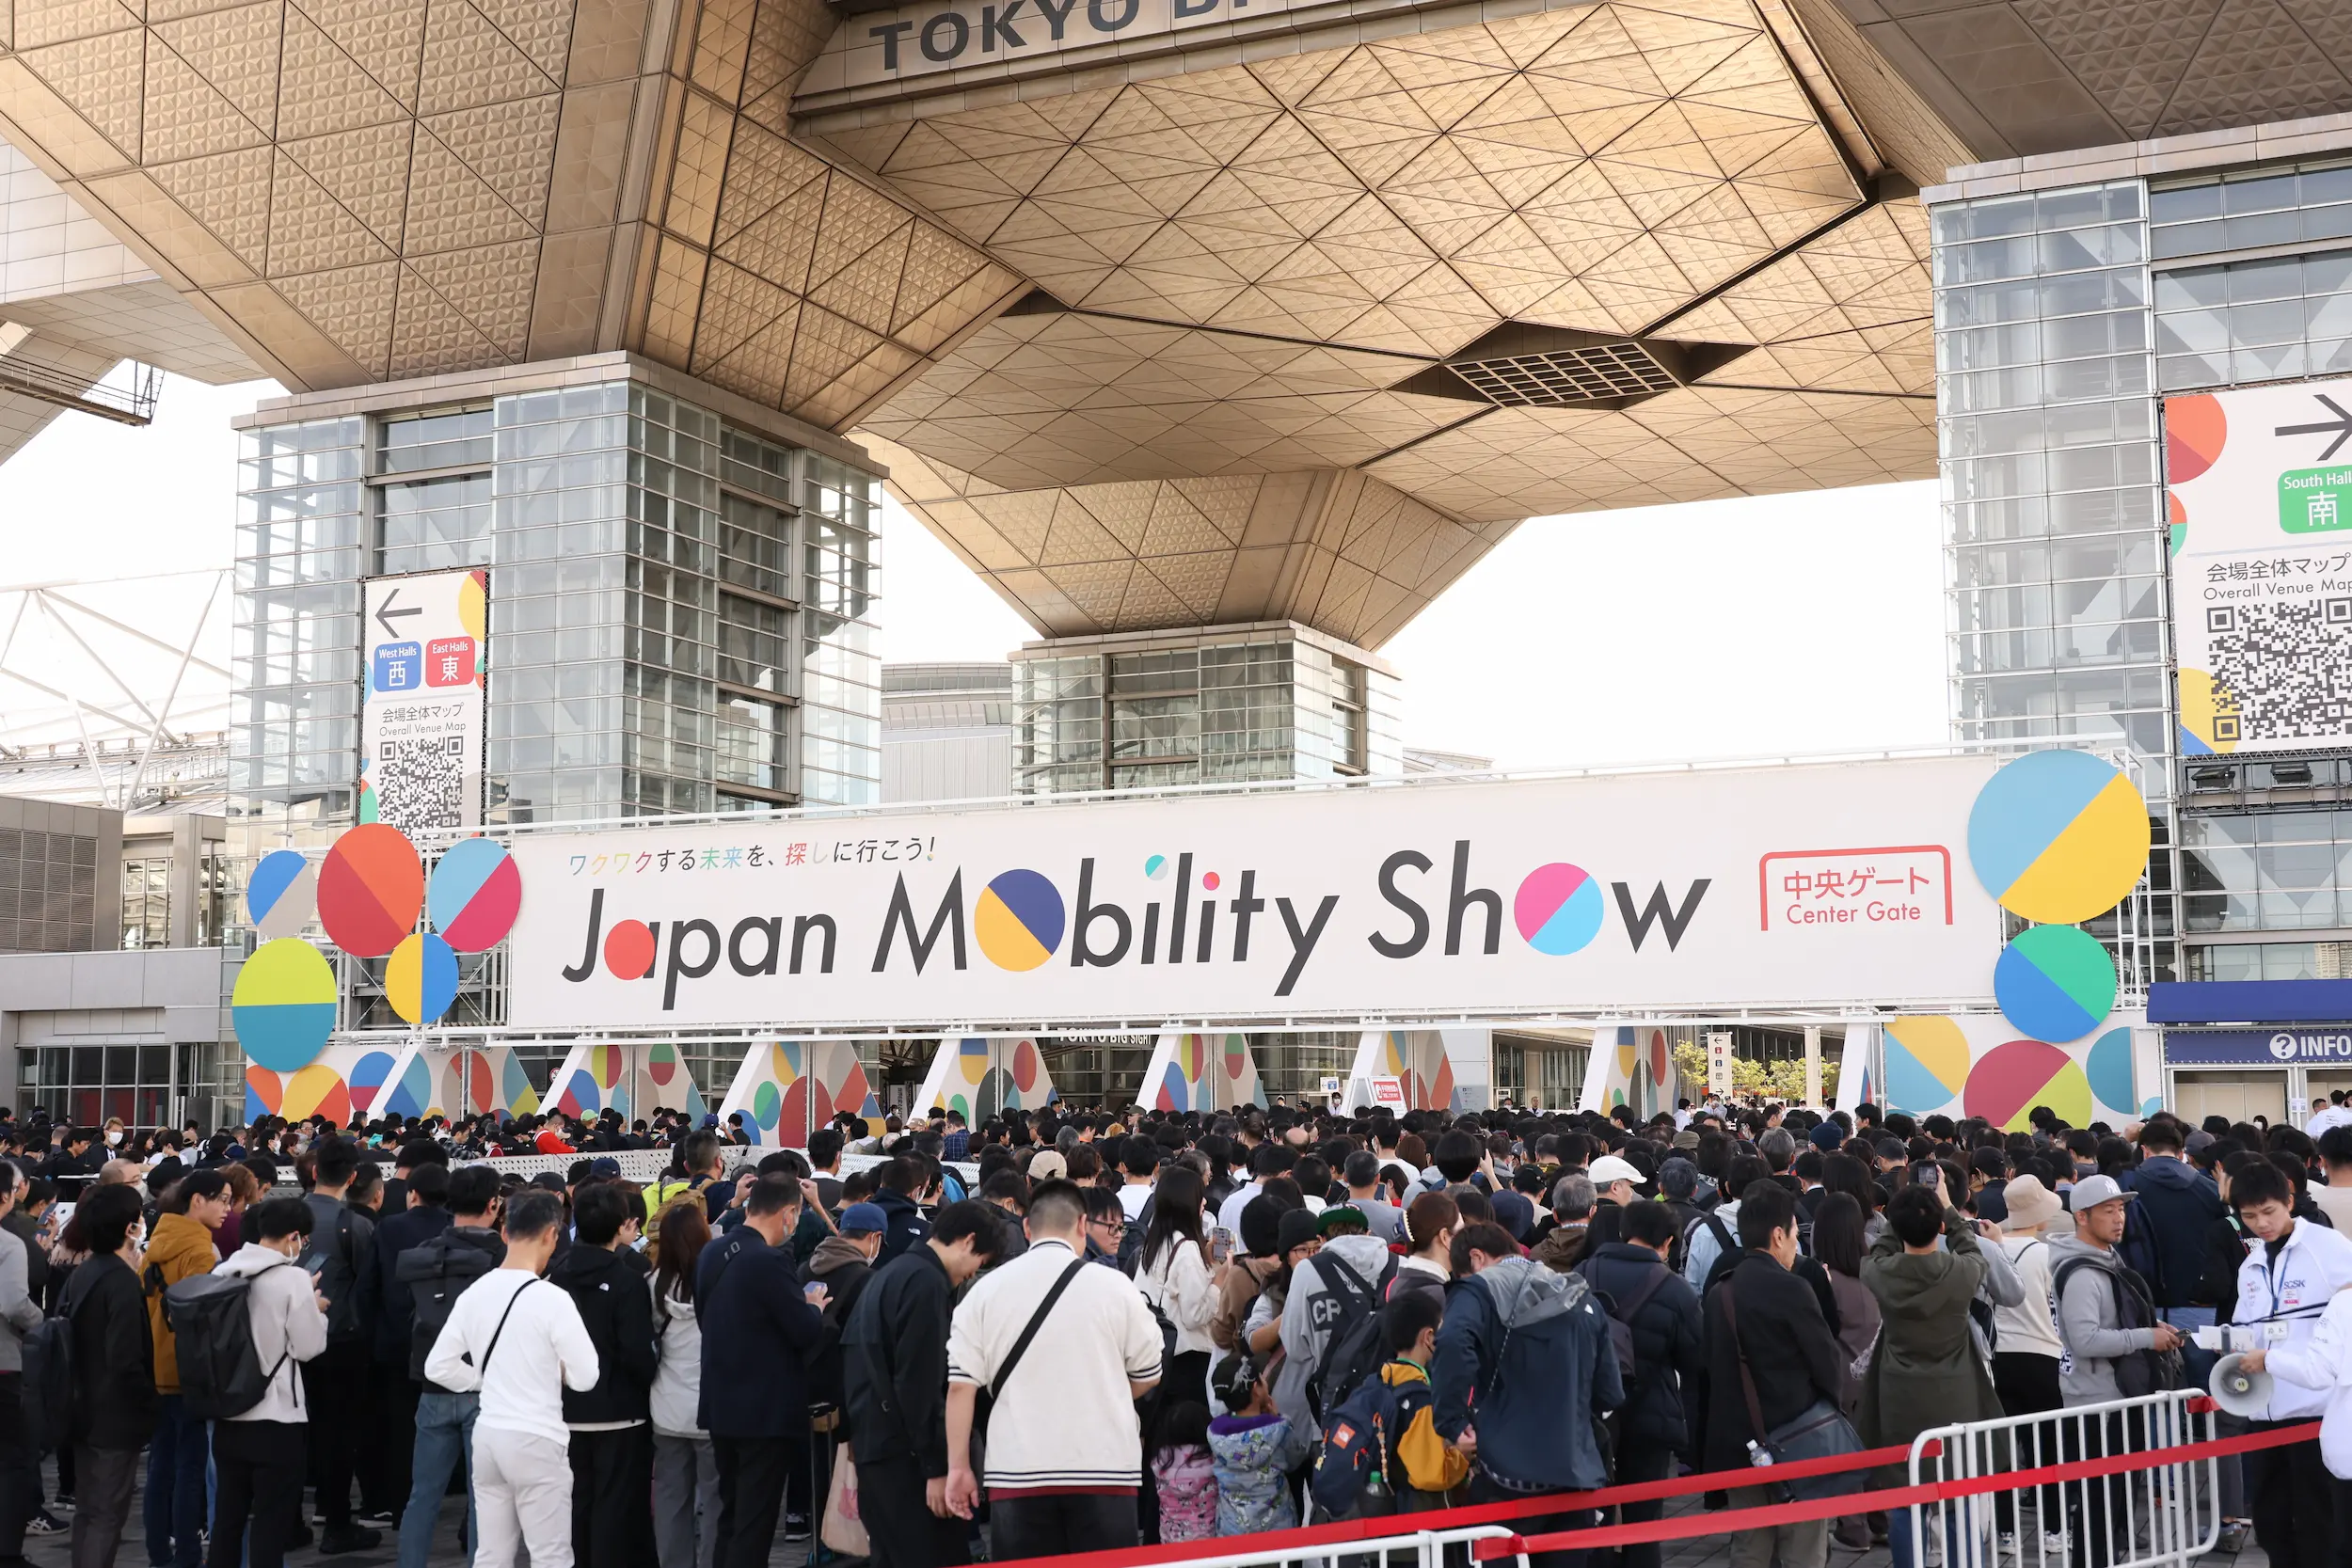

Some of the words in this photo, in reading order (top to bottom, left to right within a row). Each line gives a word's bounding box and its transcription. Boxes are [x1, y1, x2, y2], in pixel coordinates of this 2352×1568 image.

[869, 0, 1139, 71] TOKYO
[2283, 473, 2323, 489] South
[2307, 491, 2337, 526] 南
[2207, 552, 2351, 583] 会場全体マップ
[2203, 582, 2260, 600] Overall
[2265, 581, 2313, 595] Venue
[379, 648, 397, 658] West
[399, 646, 417, 657] Halls
[433, 643, 449, 654] East
[450, 641, 469, 652] Halls
[389, 660, 406, 687] 西
[441, 656, 459, 682] 東
[382, 701, 465, 723] 会場全体マップ
[379, 723, 412, 737] Overall
[414, 723, 442, 734] Venue
[445, 721, 467, 733] Map
[1784, 866, 1930, 900] 中央ゲート
[562, 888, 836, 1011] Japan
[871, 852, 1341, 997] Mobility
[1367, 839, 1712, 959] Show
[1787, 904, 1858, 925] Center
[1867, 900, 1921, 922] Gate
[1110, 1034, 1128, 1044] BIG
